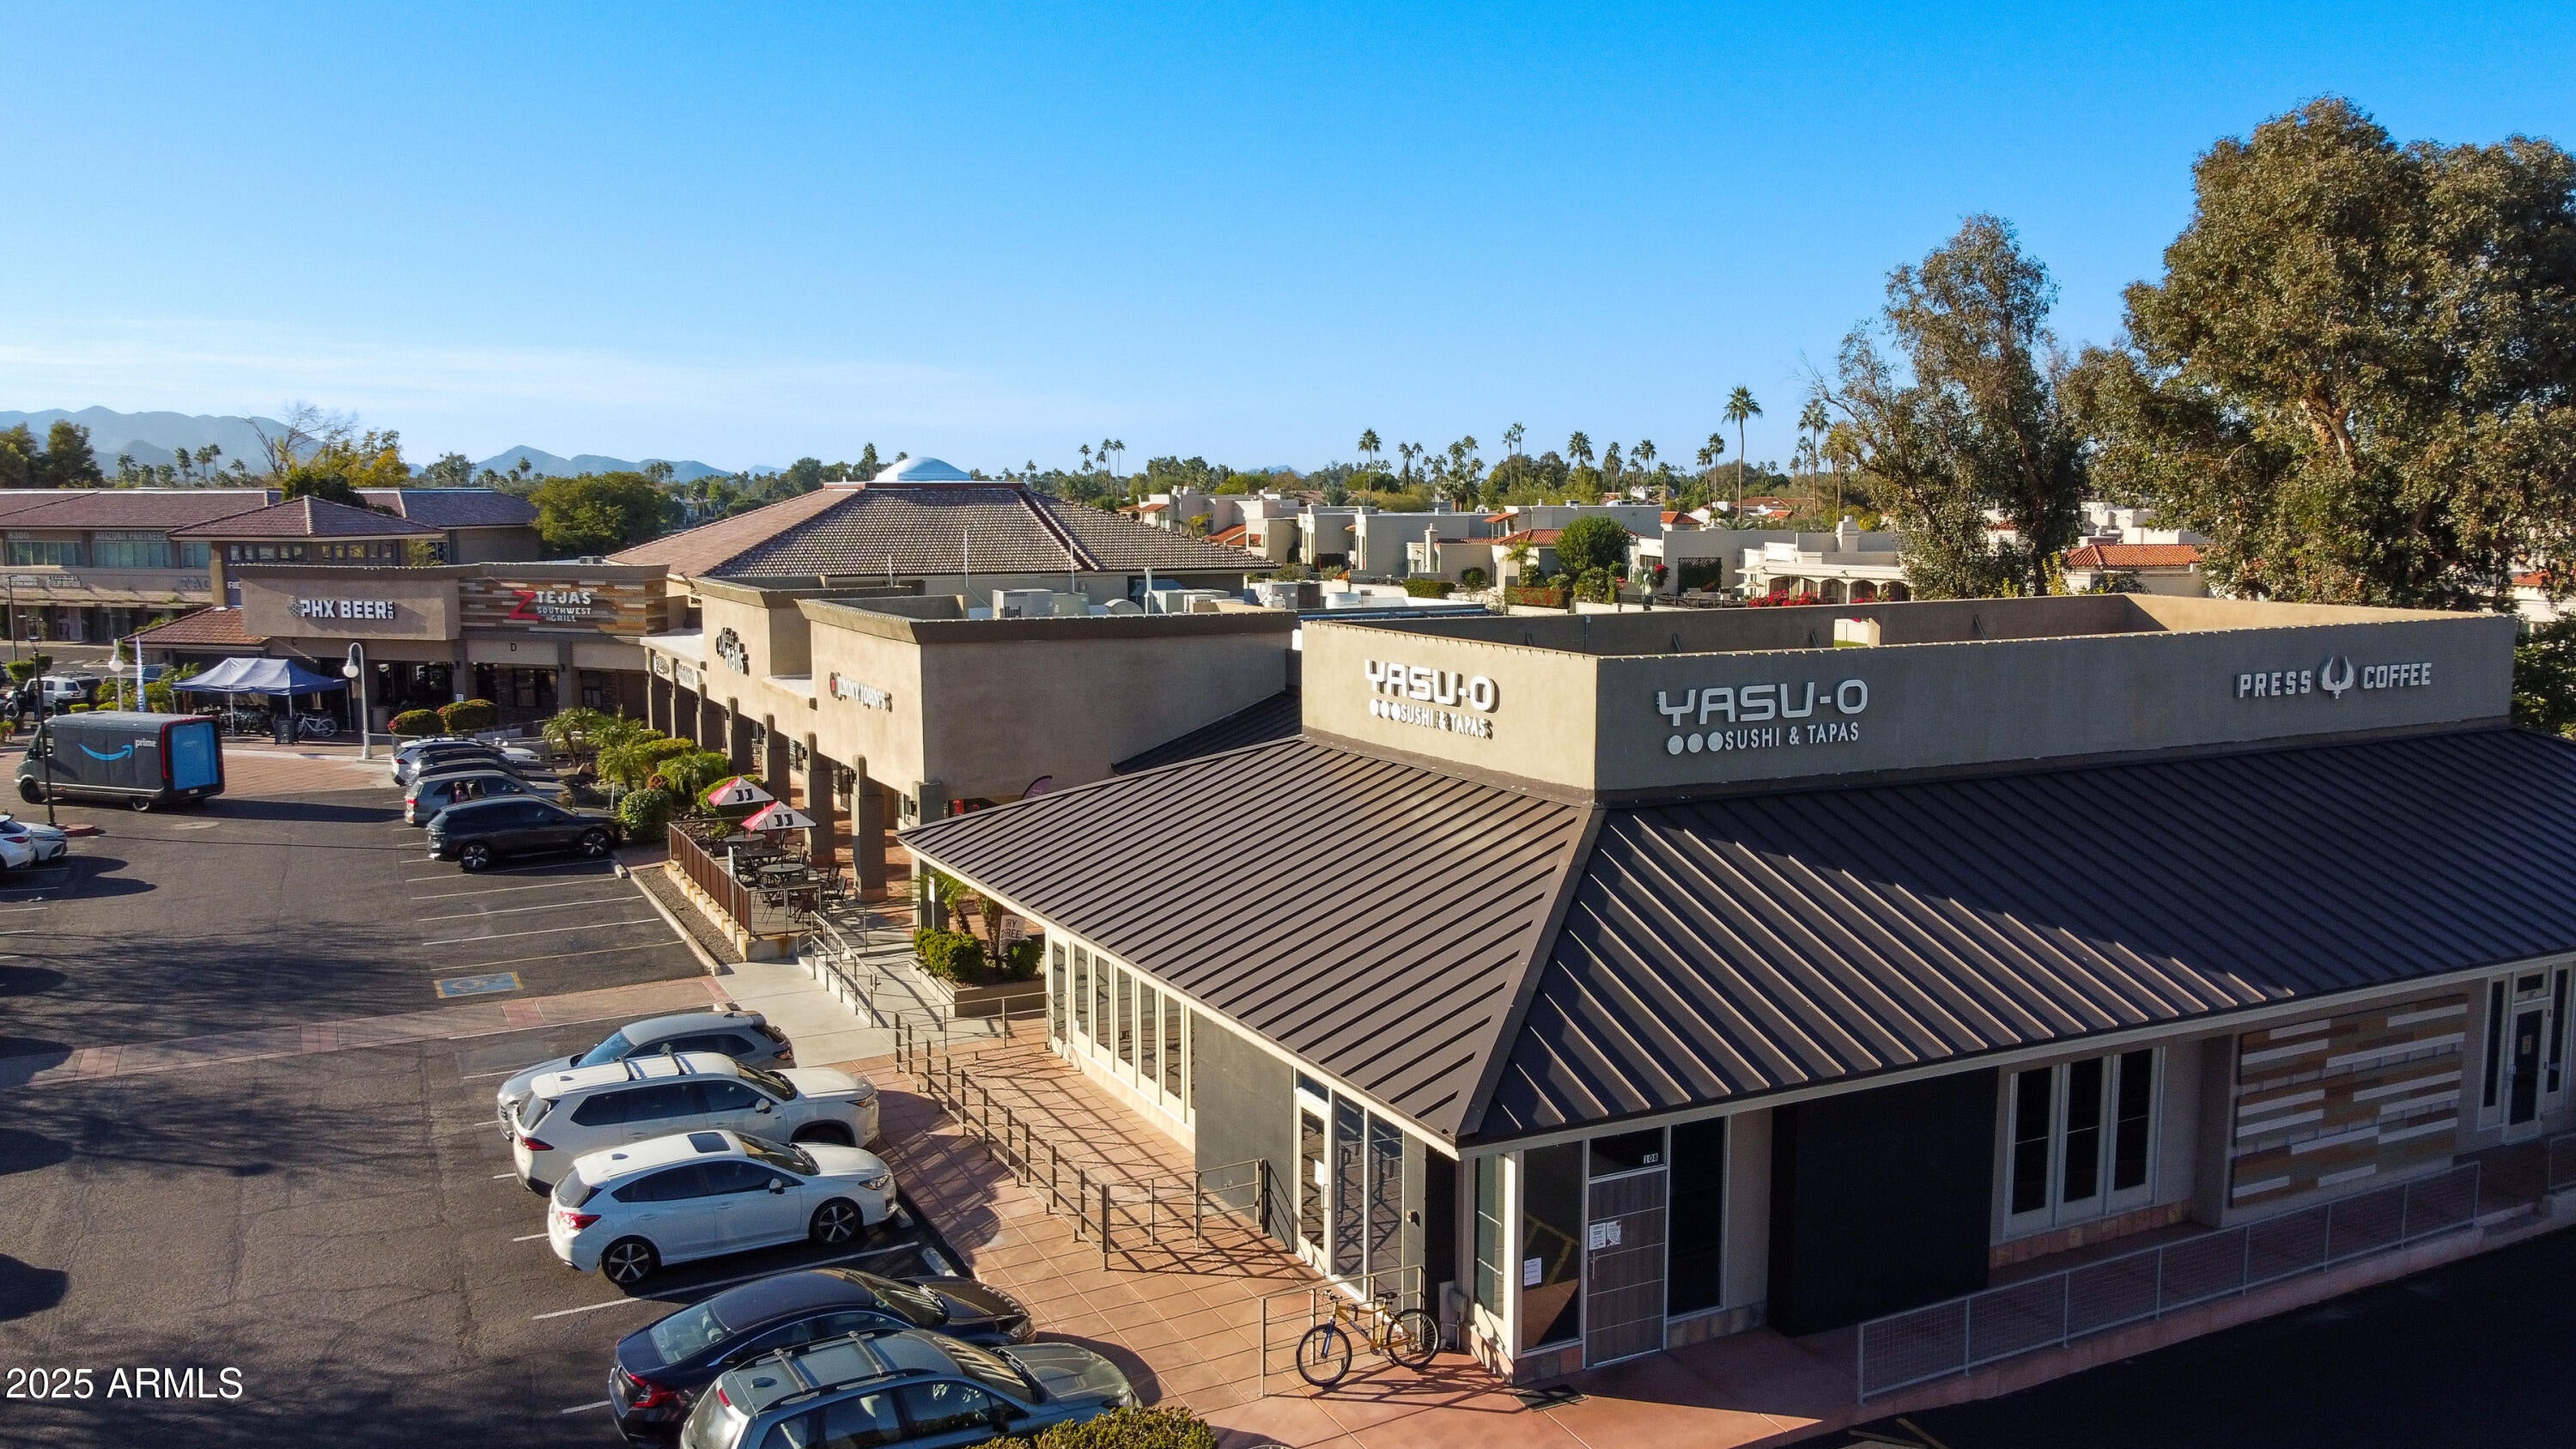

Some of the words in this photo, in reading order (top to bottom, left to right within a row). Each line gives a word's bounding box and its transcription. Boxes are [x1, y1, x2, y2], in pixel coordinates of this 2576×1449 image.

[301, 600, 337, 618] PHX
[341, 600, 386, 619] BEER
[509, 590, 545, 620] Z
[536, 591, 592, 605] TEJAS
[537, 606, 592, 615] SOUTHWEST
[511, 642, 517, 651] D
[1364, 659, 1493, 711] YASU-O
[2239, 670, 2312, 698] PRESS
[2363, 662, 2432, 689] COFFEE
[1658, 679, 1868, 727] YASU-O
[1400, 703, 1435, 728] SUSHI
[1437, 710, 1448, 730] &
[1450, 713, 1486, 739] TAPAS
[1725, 727, 1780, 751] SUSHI
[1789, 726, 1800, 746] &
[1807, 721, 1859, 744] TAPAS
[135, 738, 157, 748] prime
